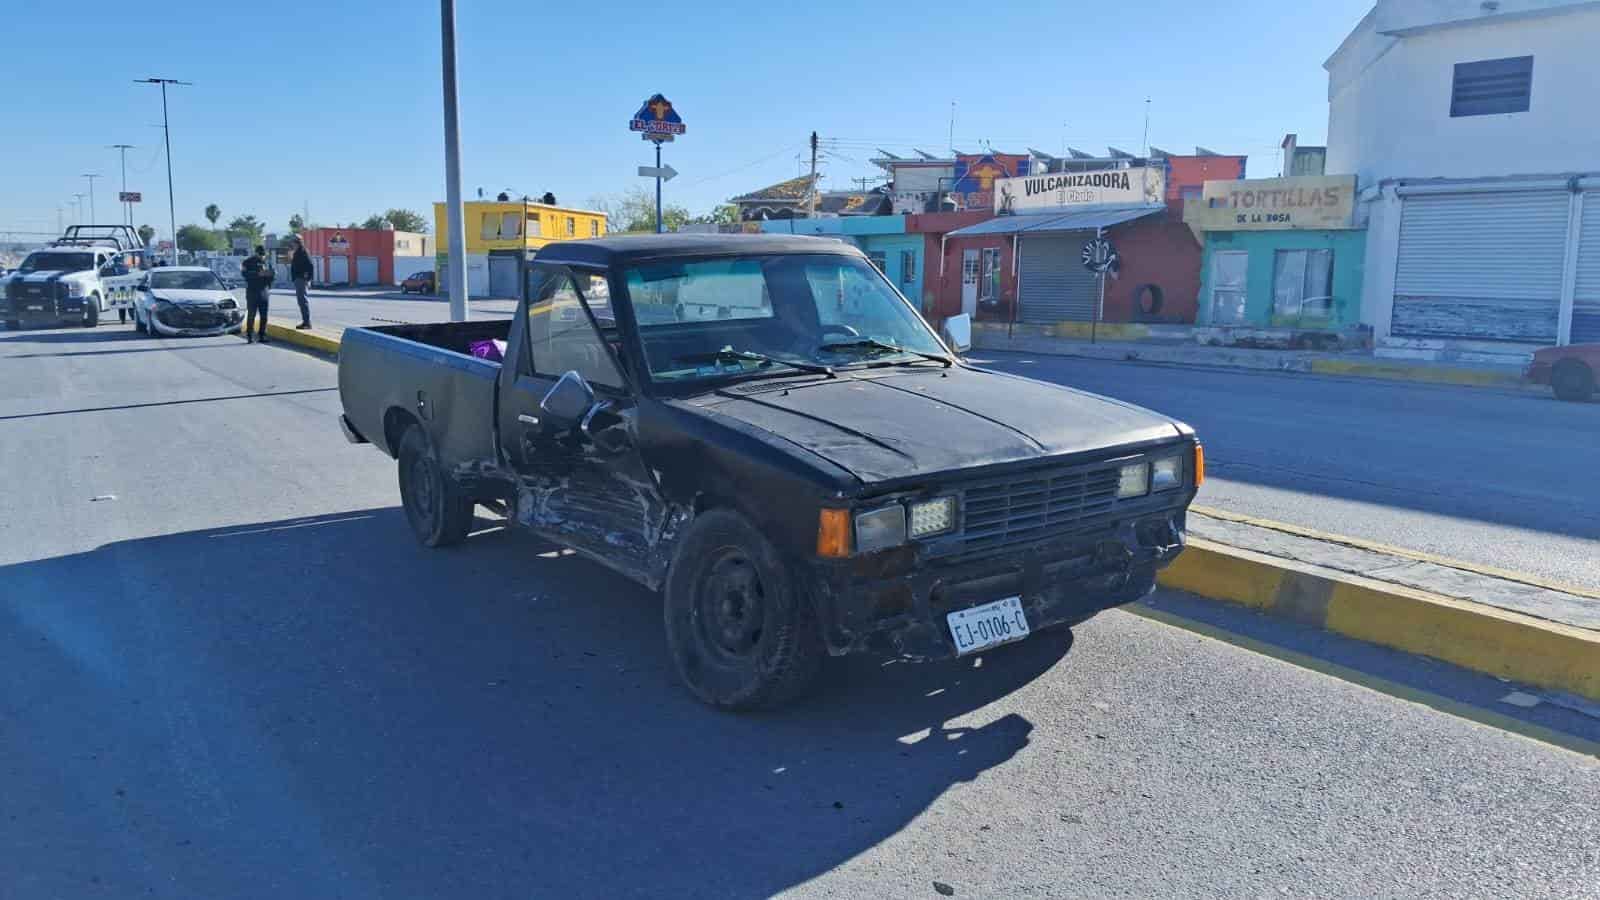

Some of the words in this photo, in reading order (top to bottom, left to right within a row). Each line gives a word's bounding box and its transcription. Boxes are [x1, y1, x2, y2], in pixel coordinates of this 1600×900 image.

[1024, 171, 1130, 197] VULCANIZADORA
[1230, 186, 1340, 209] TORTILLAS
[1237, 214, 1247, 223] DE
[1251, 214, 1262, 223] LA
[954, 610, 1026, 648] EJ-0106-C
